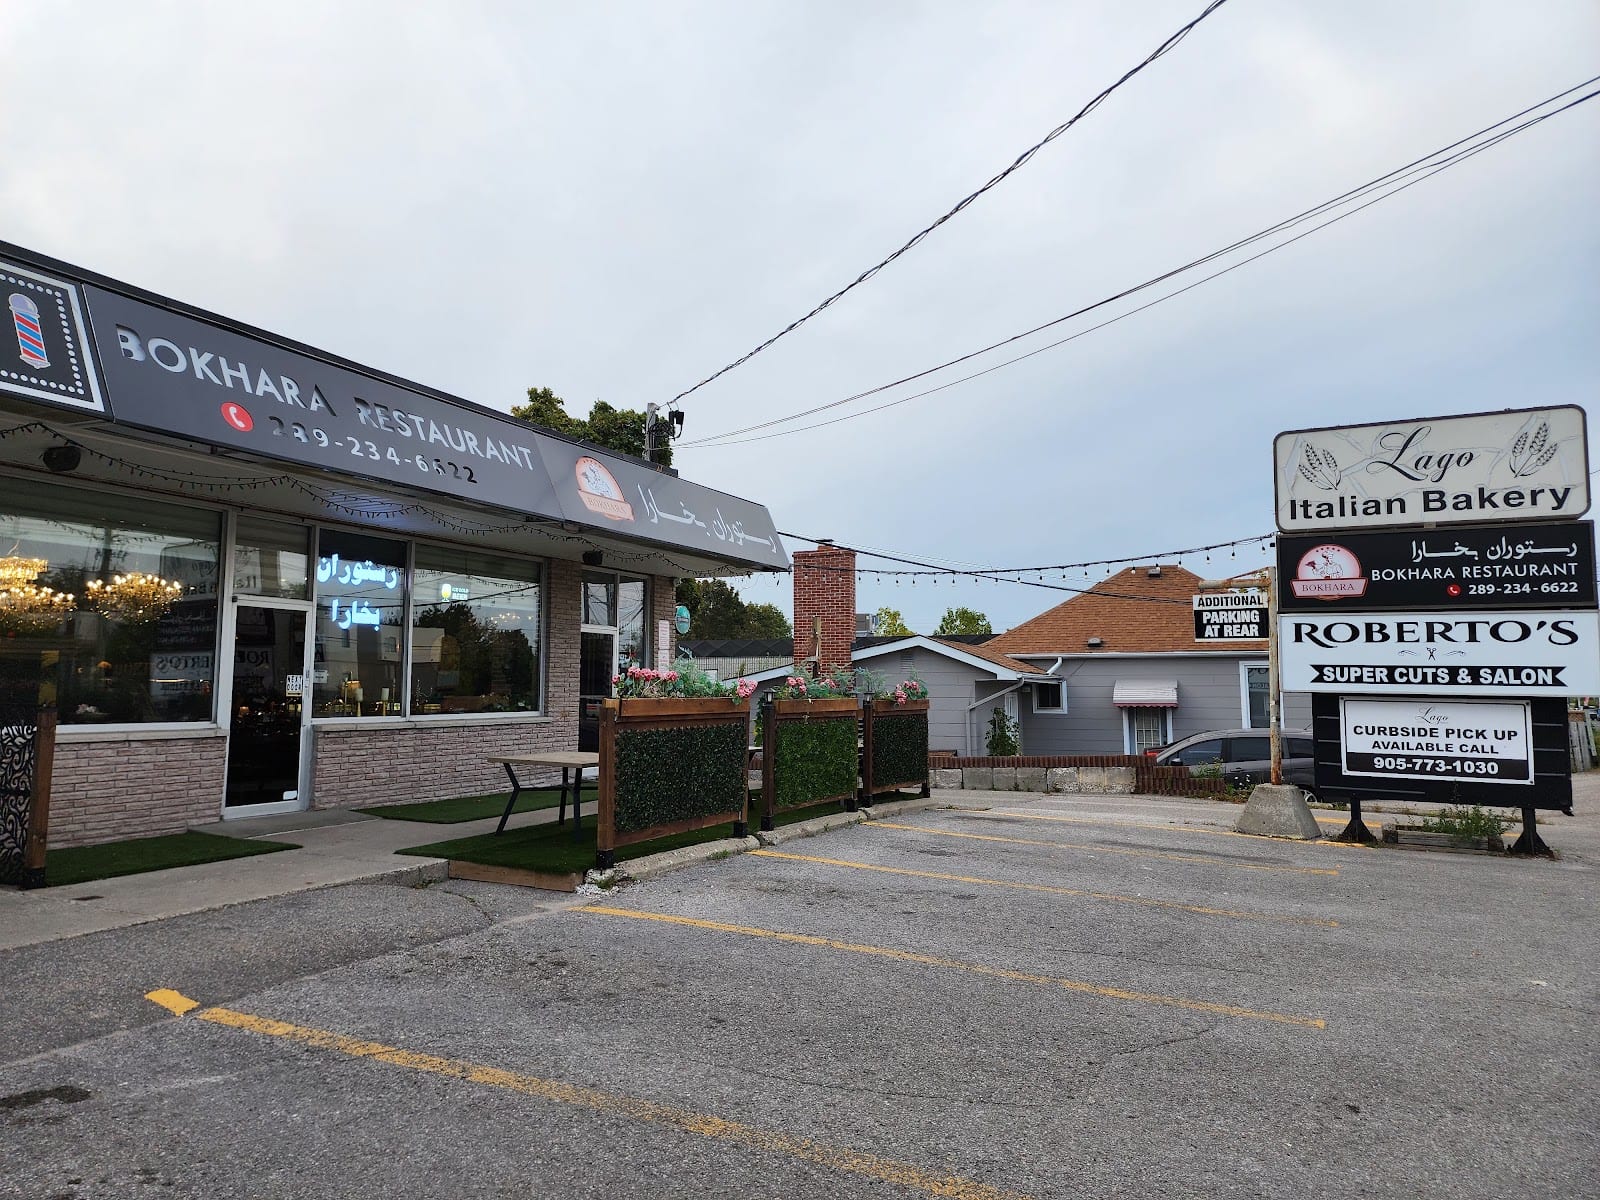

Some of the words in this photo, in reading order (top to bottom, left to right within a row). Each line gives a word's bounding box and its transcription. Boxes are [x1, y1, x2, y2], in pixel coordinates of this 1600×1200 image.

[115, 323, 337, 418] BOKHARA
[354, 396, 535, 471] RESTAURANT
[1366, 425, 1475, 483] Lago
[1290, 495, 1406, 520] Italian
[1422, 487, 1571, 513] Bakery
[1371, 567, 1455, 581] BOKHARA
[1462, 562, 1579, 579] RESTAURANT
[1301, 583, 1355, 592] BOKHARA
[1468, 581, 1579, 595] 289-234-6622
[1197, 595, 1264, 607] ADDITIONAL
[1202, 610, 1260, 624] PARKING
[1204, 624, 1220, 637] AT
[1223, 624, 1259, 637] REAR
[1293, 620, 1579, 648] ROBERTO'S
[1322, 666, 1389, 683] SUPER
[1394, 667, 1450, 684] CUTS
[1456, 667, 1472, 684] &
[1479, 667, 1553, 685] SALON
[1416, 706, 1448, 725] Lago
[1353, 725, 1440, 738] CURBSIDE
[1445, 728, 1488, 740] PICK
[1493, 729, 1518, 741] UP
[1372, 740, 1454, 753] AVAILABLE
[1459, 743, 1499, 755] CALL
[1373, 756, 1499, 775] 905-773-1030
